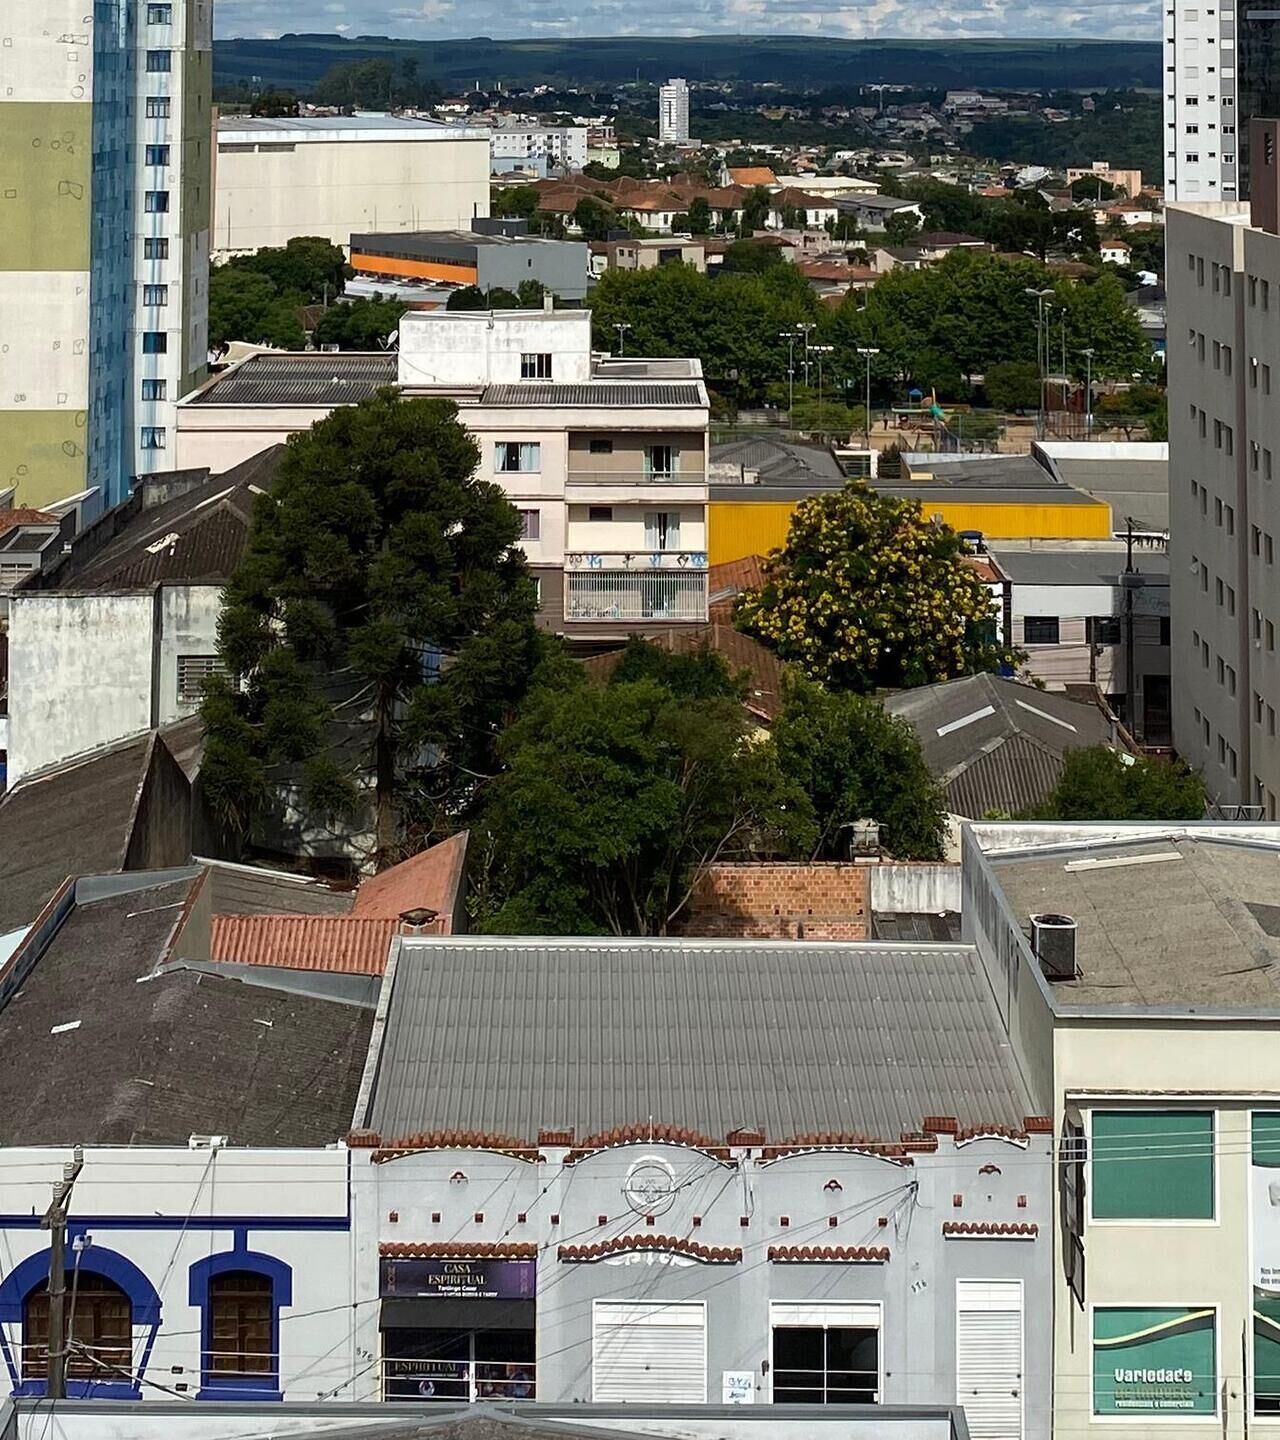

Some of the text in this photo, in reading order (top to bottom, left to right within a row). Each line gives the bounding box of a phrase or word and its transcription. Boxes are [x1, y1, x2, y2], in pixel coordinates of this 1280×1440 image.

[444, 1264, 471, 1273] CASA
[428, 1274, 487, 1285] ESPIRITUAL
[1114, 1368, 1193, 1384] Variedade
